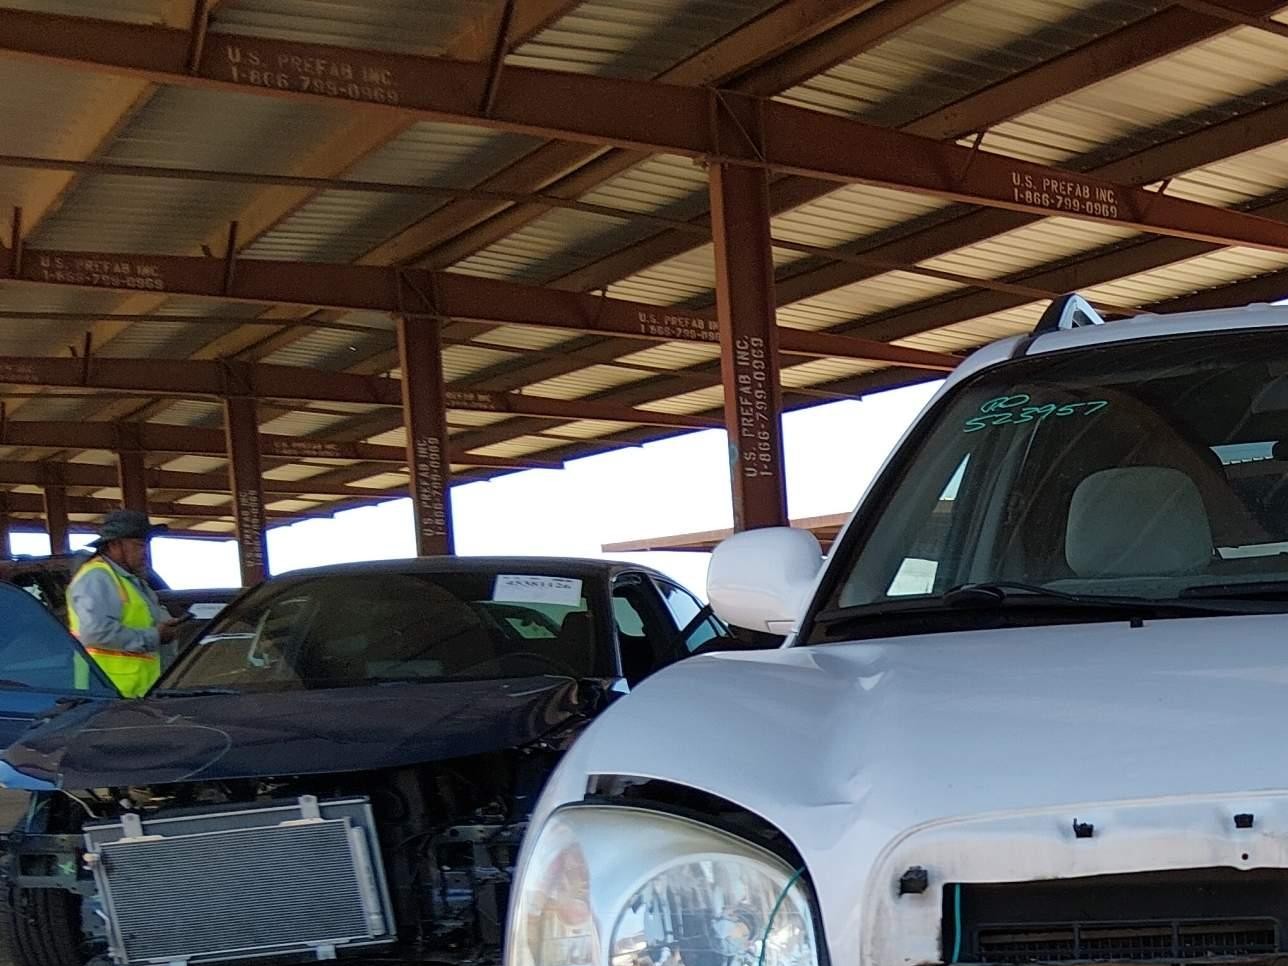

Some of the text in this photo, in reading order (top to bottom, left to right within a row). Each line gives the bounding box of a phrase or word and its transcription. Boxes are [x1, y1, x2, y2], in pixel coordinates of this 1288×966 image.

[277, 54, 353, 80] PREFAB
[1012, 172, 1118, 205] U.S. PREFAB INC.
[1014, 188, 1118, 218] 1-866-799-0969
[736, 335, 750, 366] INC.
[738, 374, 755, 438] PREFAB
[751, 336, 773, 476] 1-866-799-0969
[963, 400, 1108, 433] 523957
